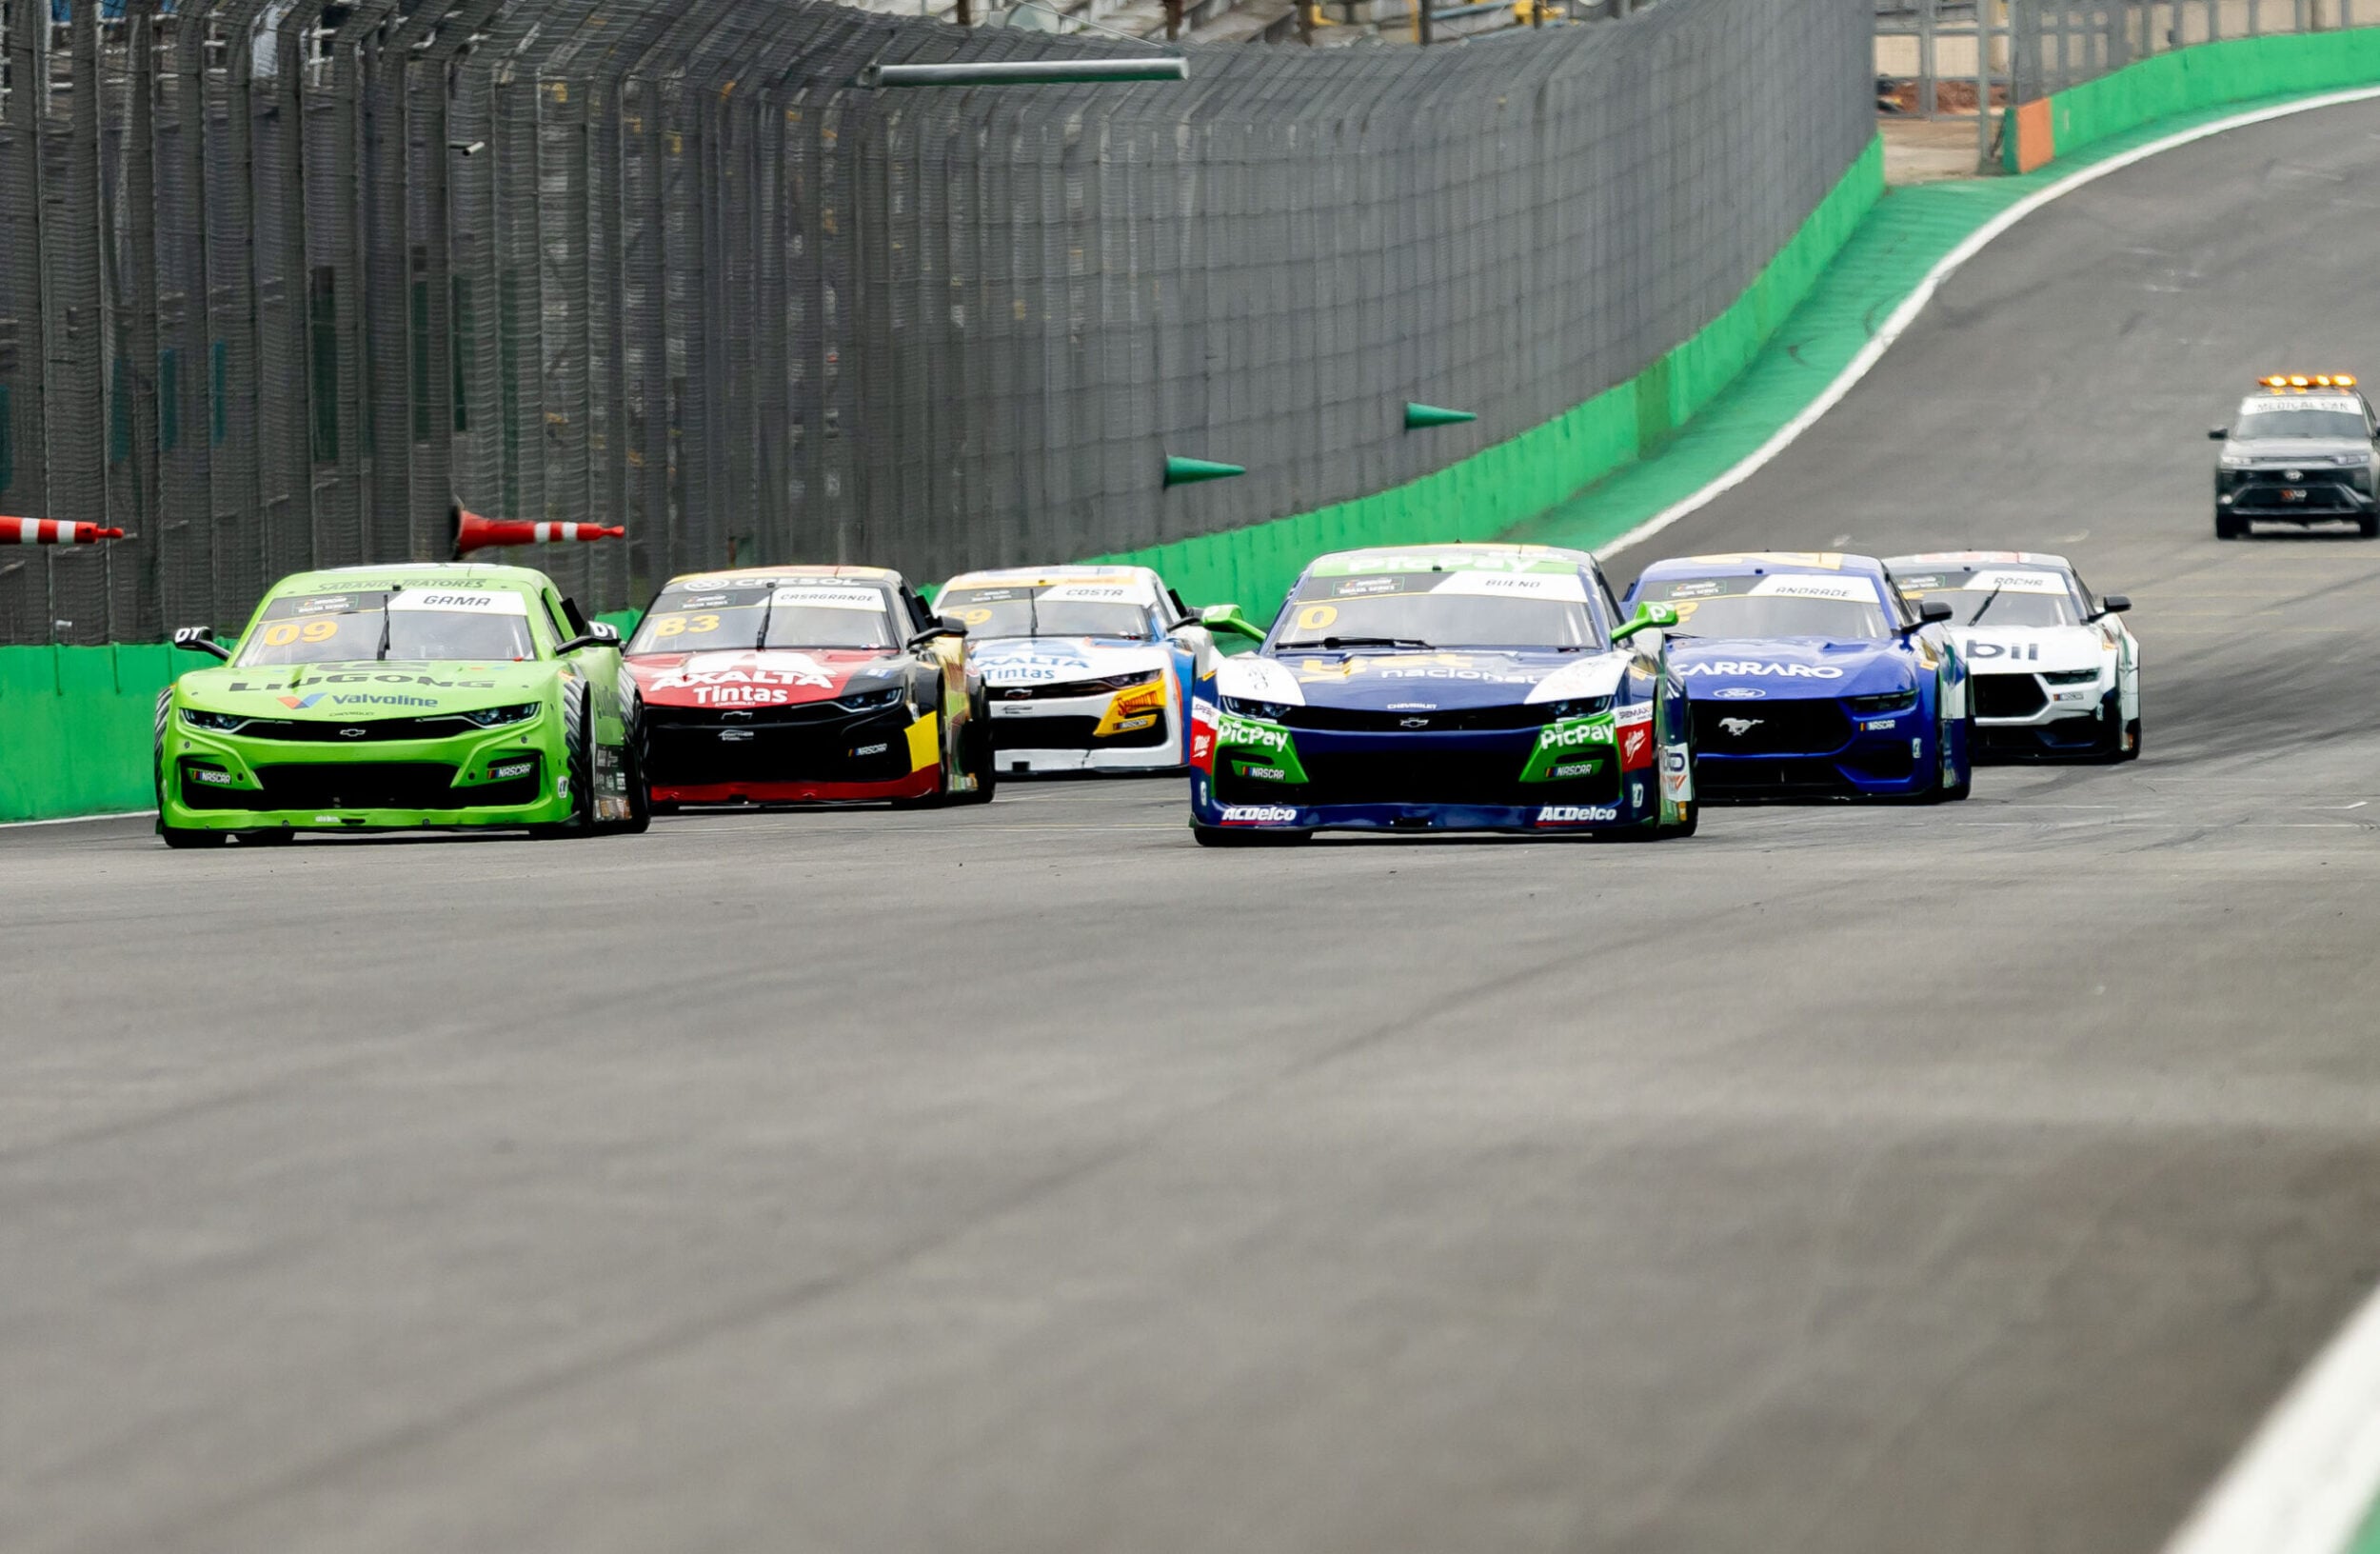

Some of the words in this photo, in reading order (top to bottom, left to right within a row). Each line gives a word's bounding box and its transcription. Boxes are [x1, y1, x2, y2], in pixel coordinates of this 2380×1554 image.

[2257, 401, 2314, 411] MEDICAL
[2321, 401, 2350, 411] CAR
[735, 577, 862, 588] CRESOL
[1485, 578, 1541, 588] BUENO
[1993, 576, 2044, 587] ROCHA
[780, 593, 877, 603] CASAGRANDE
[1065, 588, 1124, 597] COSTA
[1775, 587, 1852, 597] ANDRADE
[423, 595, 492, 607] GAMA
[1298, 606, 1339, 630] 0
[655, 614, 721, 637] 83
[265, 620, 338, 647] 09
[1966, 639, 2038, 660] bil
[974, 656, 1089, 668] XALTA
[649, 669, 834, 692] AXALTA
[983, 667, 1055, 680] Tintas
[228, 673, 496, 692] LIUGONG
[332, 692, 439, 707] Valvoline
[693, 685, 788, 705] Tintas
[1219, 721, 1288, 752] PicPay
[1540, 722, 1615, 750] PicPay
[202, 770, 231, 785] NASCAR
[498, 764, 532, 778] NASCAR
[1252, 767, 1285, 780] NASCAR
[1556, 764, 1593, 777] NASCAR
[1221, 807, 1297, 822] ACDelco
[1537, 807, 1617, 822] ACDelco
